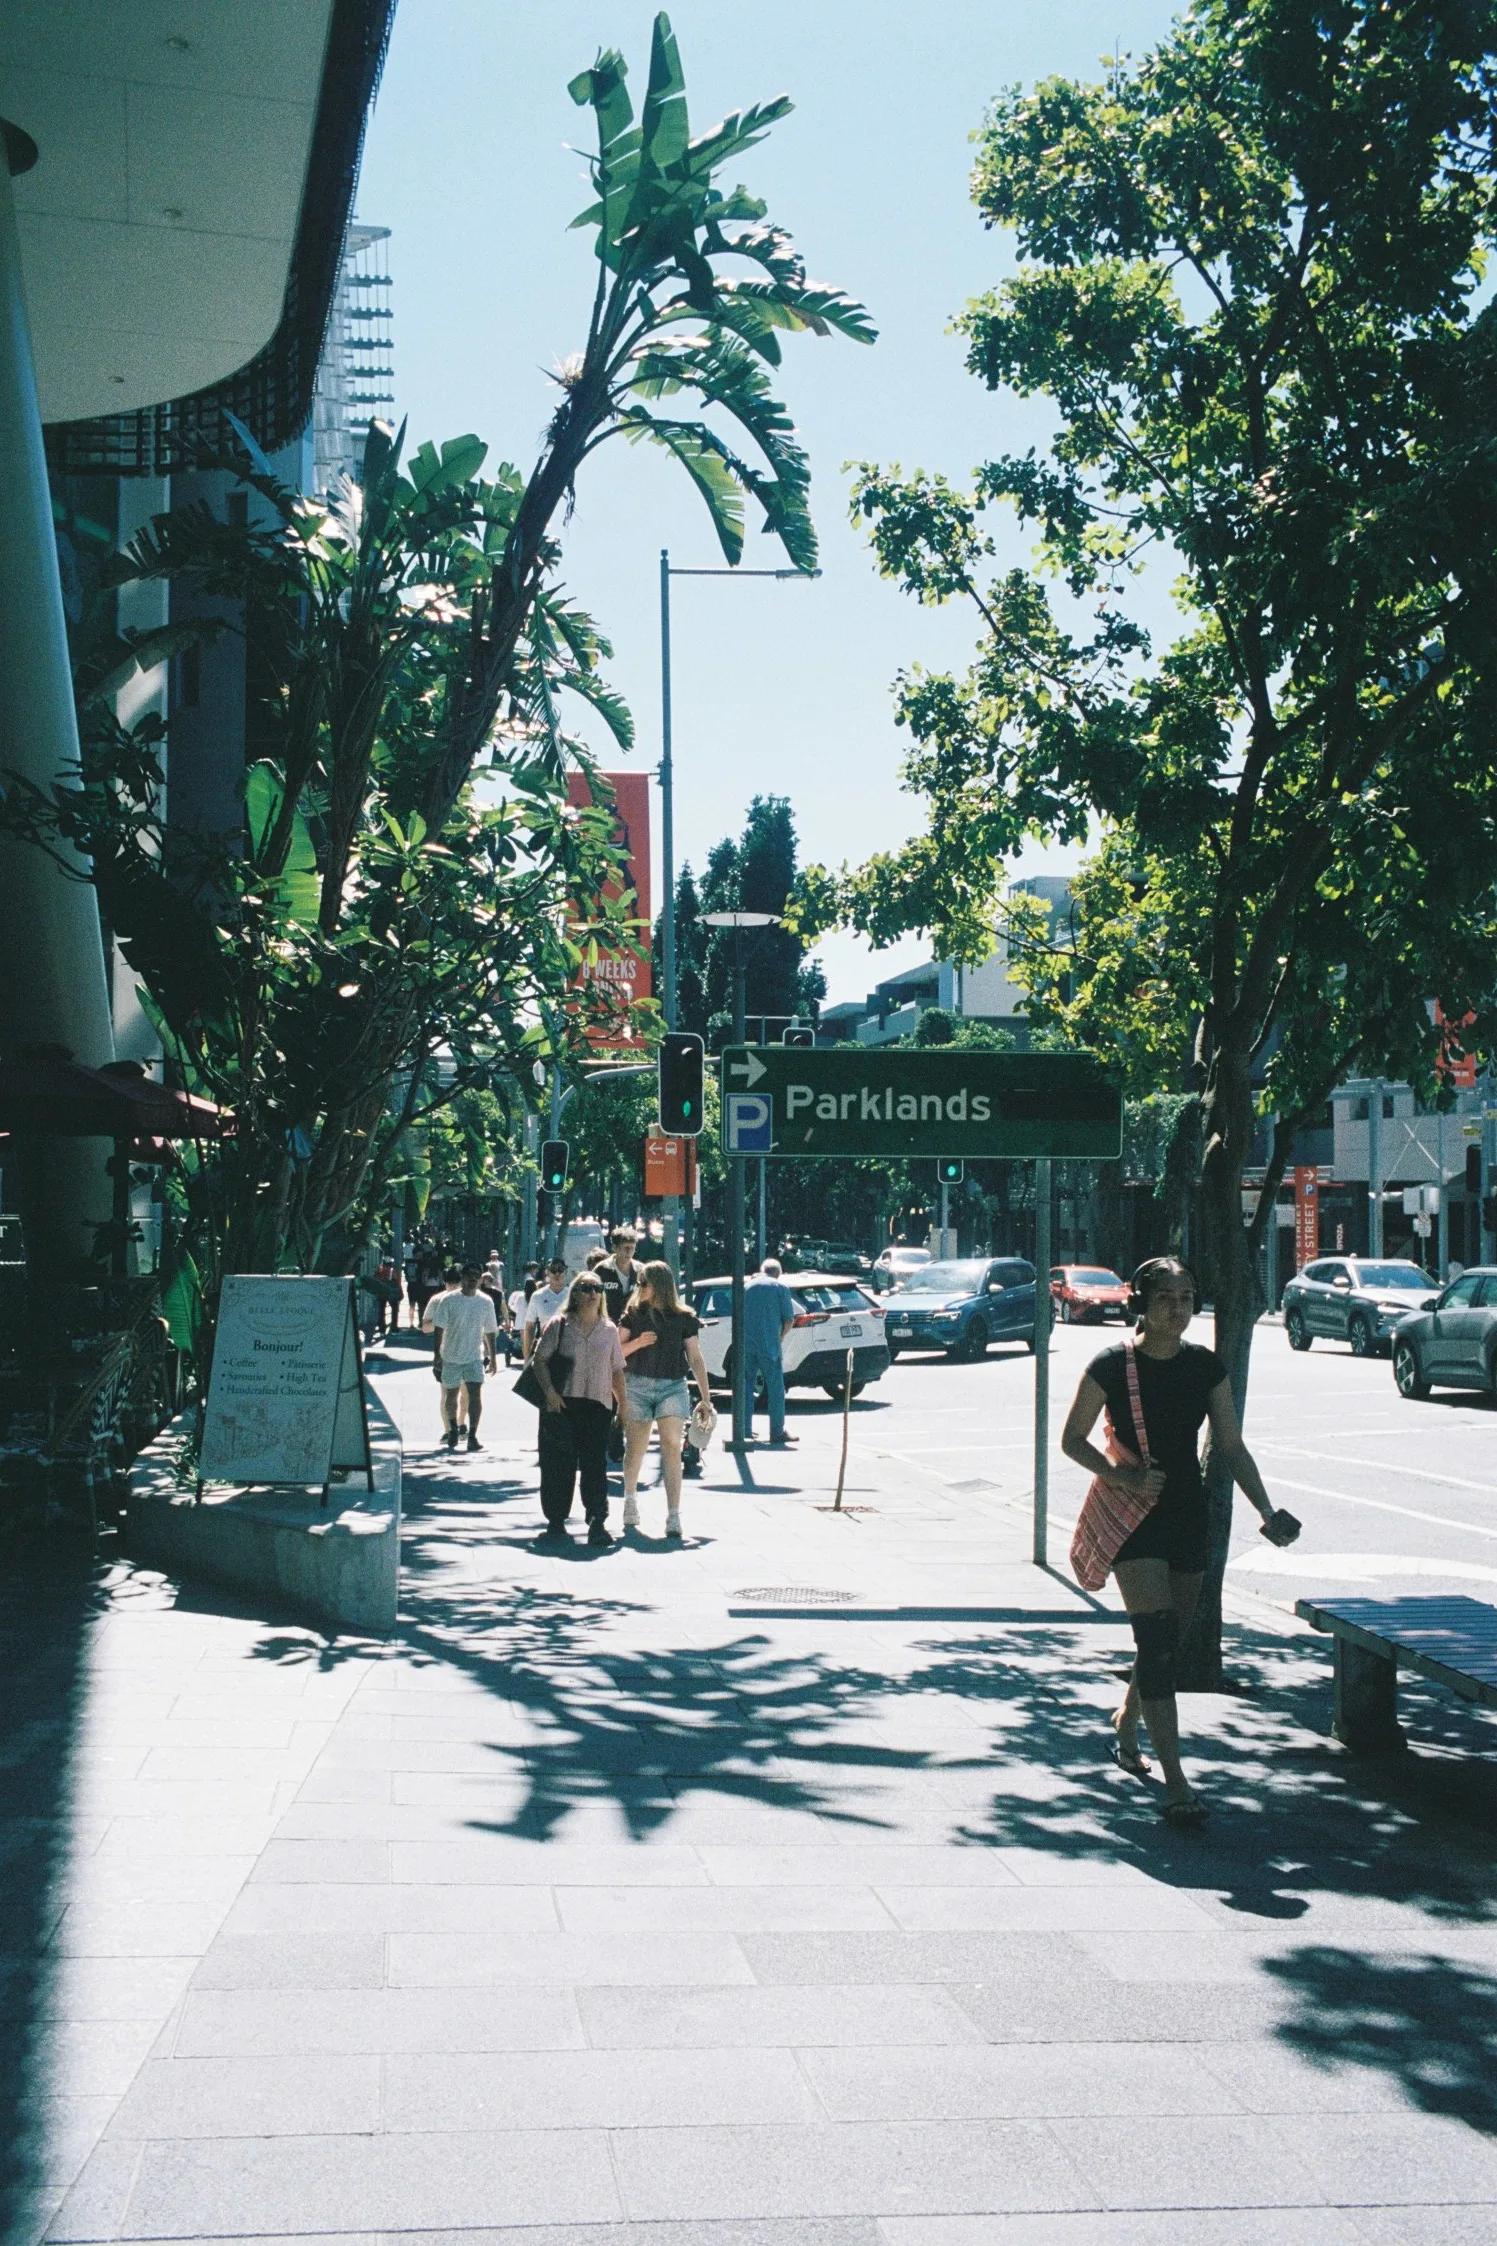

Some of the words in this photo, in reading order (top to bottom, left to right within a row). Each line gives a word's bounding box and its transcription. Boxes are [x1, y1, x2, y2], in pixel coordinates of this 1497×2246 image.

[595, 959, 636, 978] WEEKS
[786, 1085, 991, 1121] Parklands
[729, 1096, 768, 1149] P
[1304, 1203, 1314, 1248] STREET
[253, 1339, 303, 1354] Bonjour!
[229, 1358, 257, 1368] Coffee
[285, 1372, 308, 1384] High
[311, 1373, 327, 1383] Tea
[226, 1384, 279, 1395] Handcrafted
[280, 1386, 327, 1397] Chocolates
